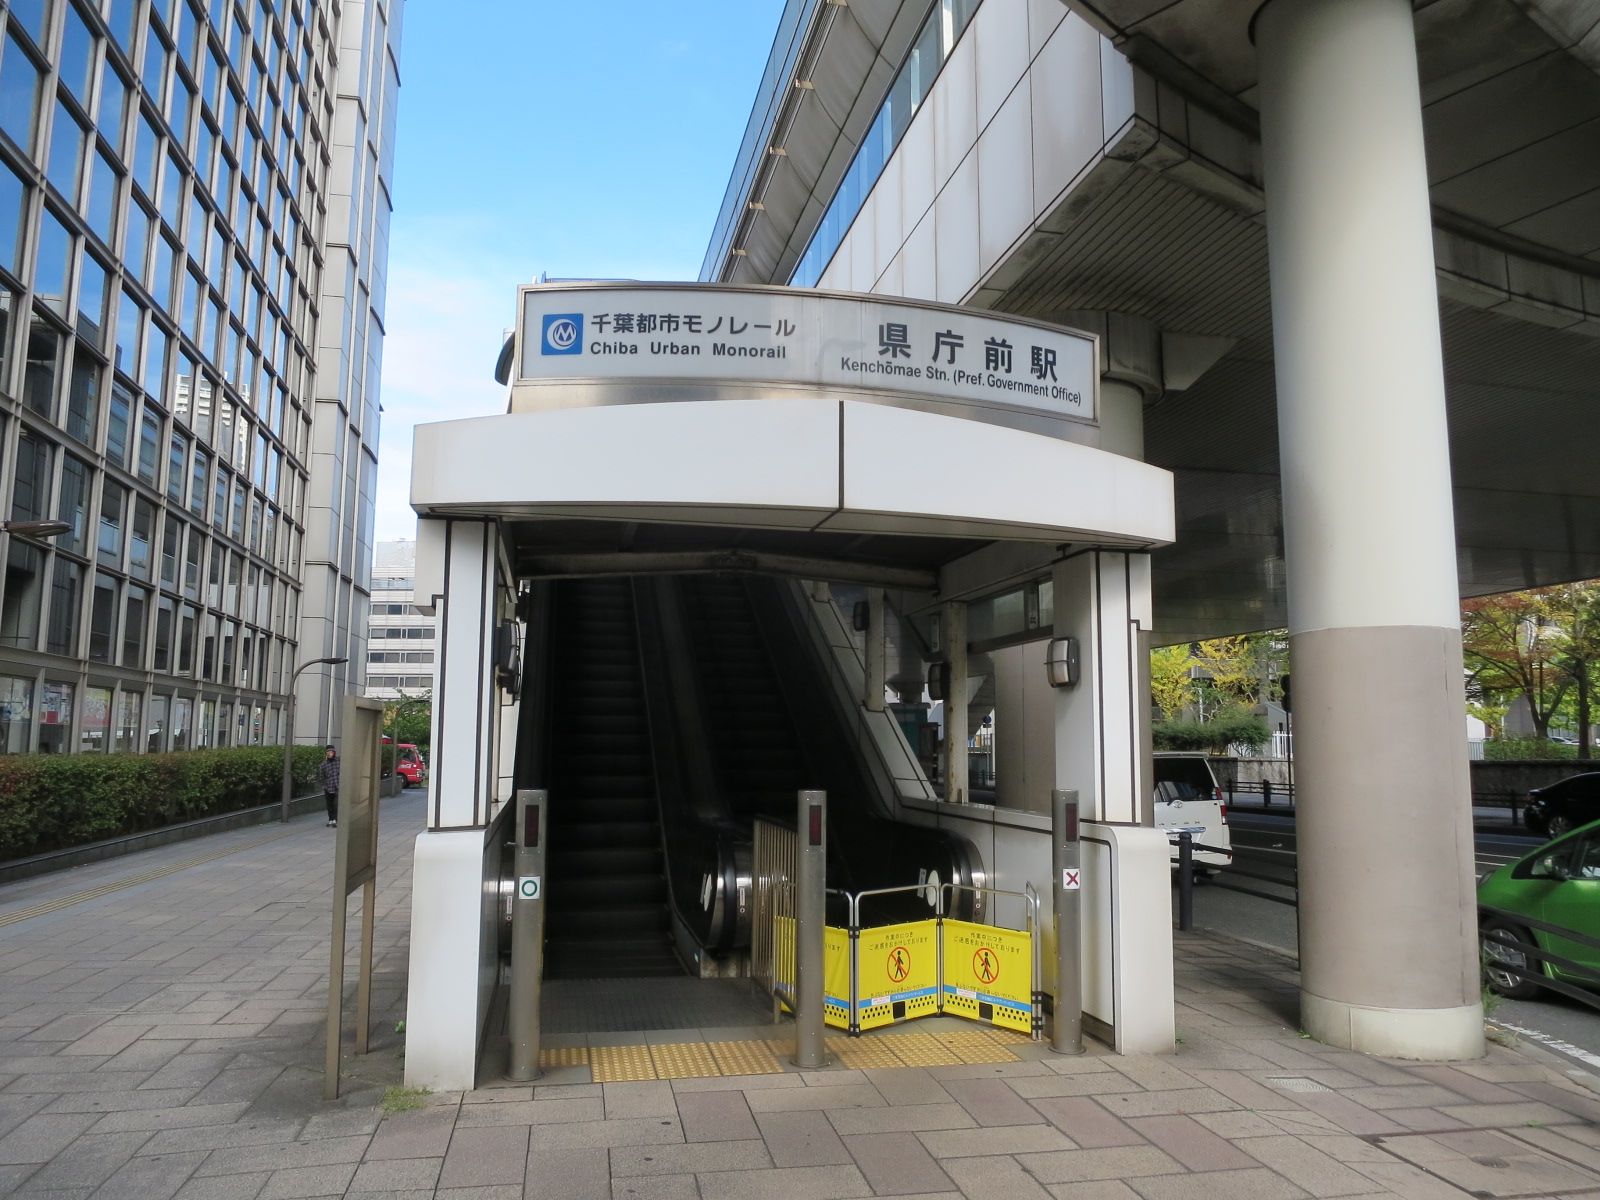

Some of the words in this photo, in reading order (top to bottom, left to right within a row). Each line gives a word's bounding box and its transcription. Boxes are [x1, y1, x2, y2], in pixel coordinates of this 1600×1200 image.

[591, 313, 796, 337] 千葉都市モノレール
[590, 341, 639, 355] Chiba
[650, 342, 701, 355] Urban
[712, 342, 786, 359] Monorail
[878, 322, 1058, 383] 県庁前駅
[841, 357, 921, 378] Kenchōmae
[926, 366, 950, 381] Stn.
[953, 370, 985, 386] (Pref.
[987, 373, 1049, 398] Government
[1051, 386, 1082, 406] Office)
